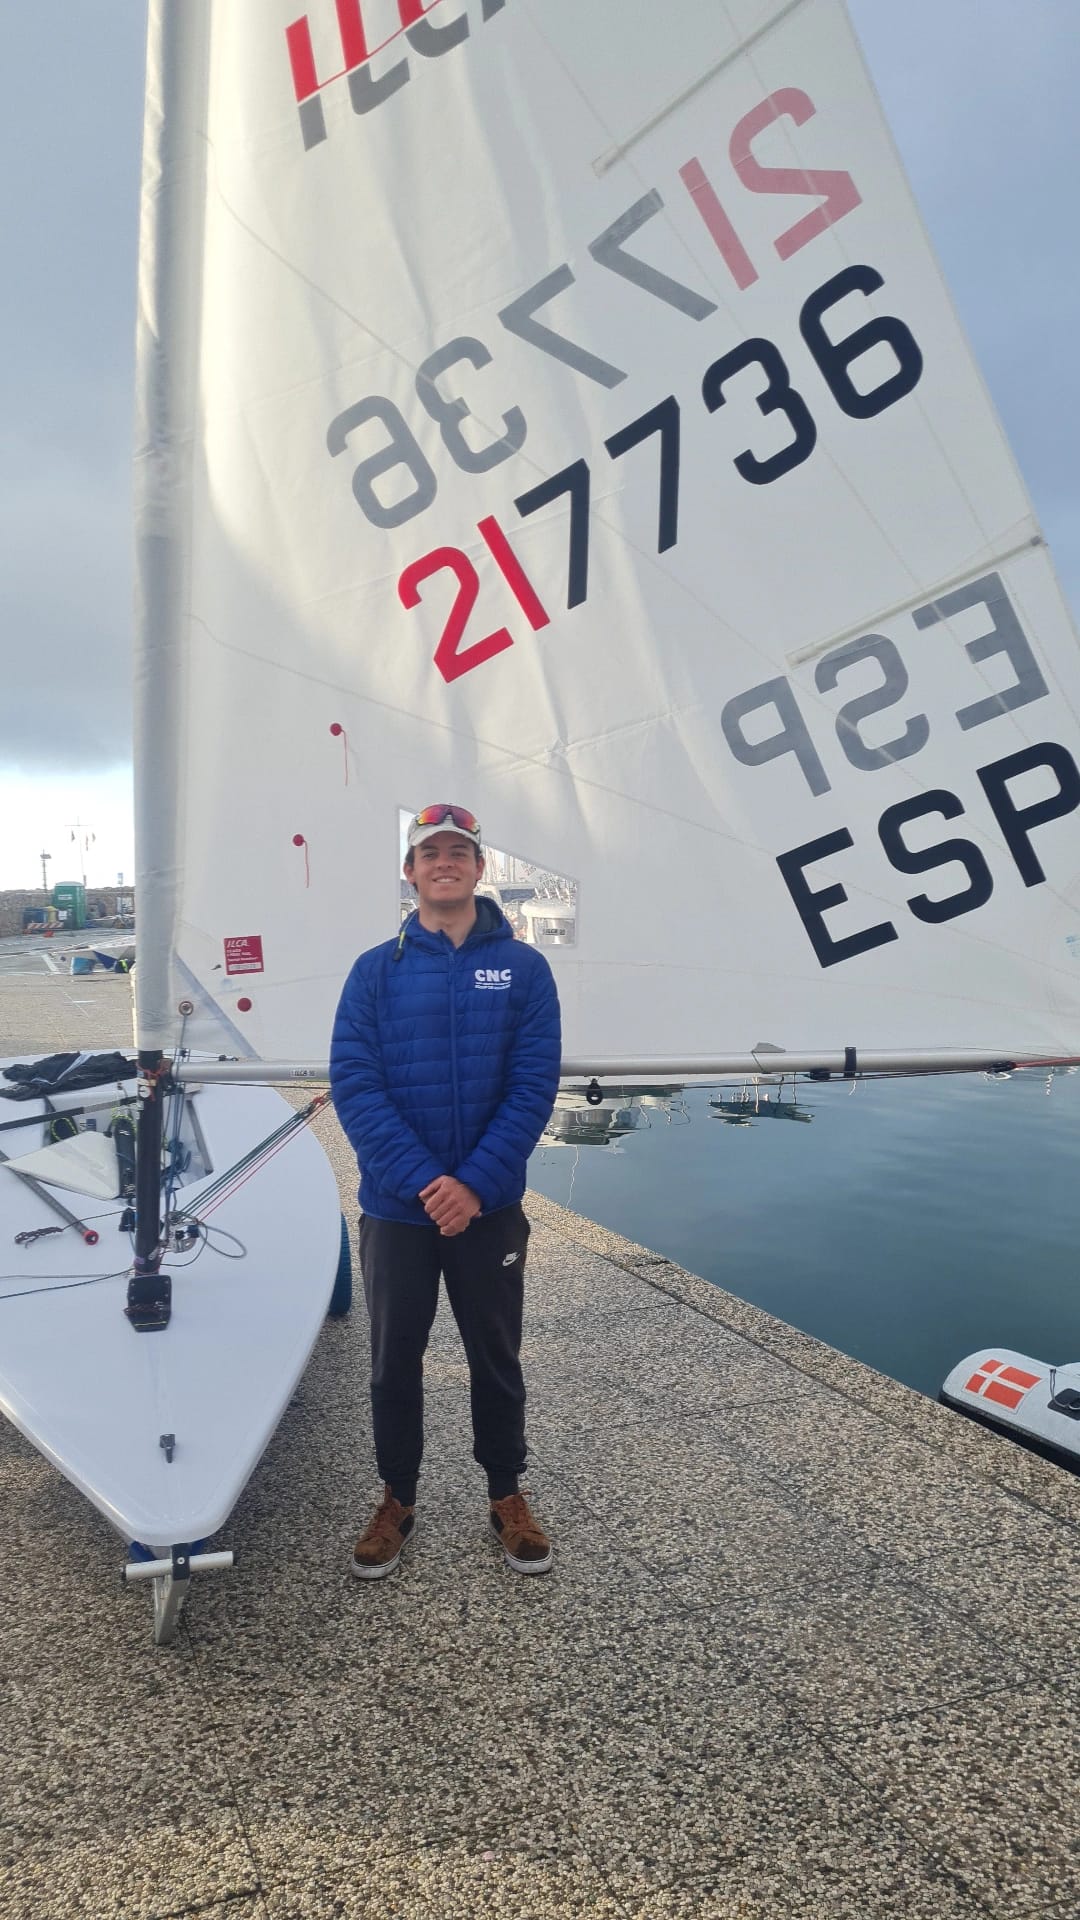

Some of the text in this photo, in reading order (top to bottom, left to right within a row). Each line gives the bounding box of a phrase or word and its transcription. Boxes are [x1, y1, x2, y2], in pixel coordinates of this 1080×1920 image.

[397, 264, 923, 684] 217736
[775, 741, 1080, 969] ESP
[474, 968, 512, 982] CNC
